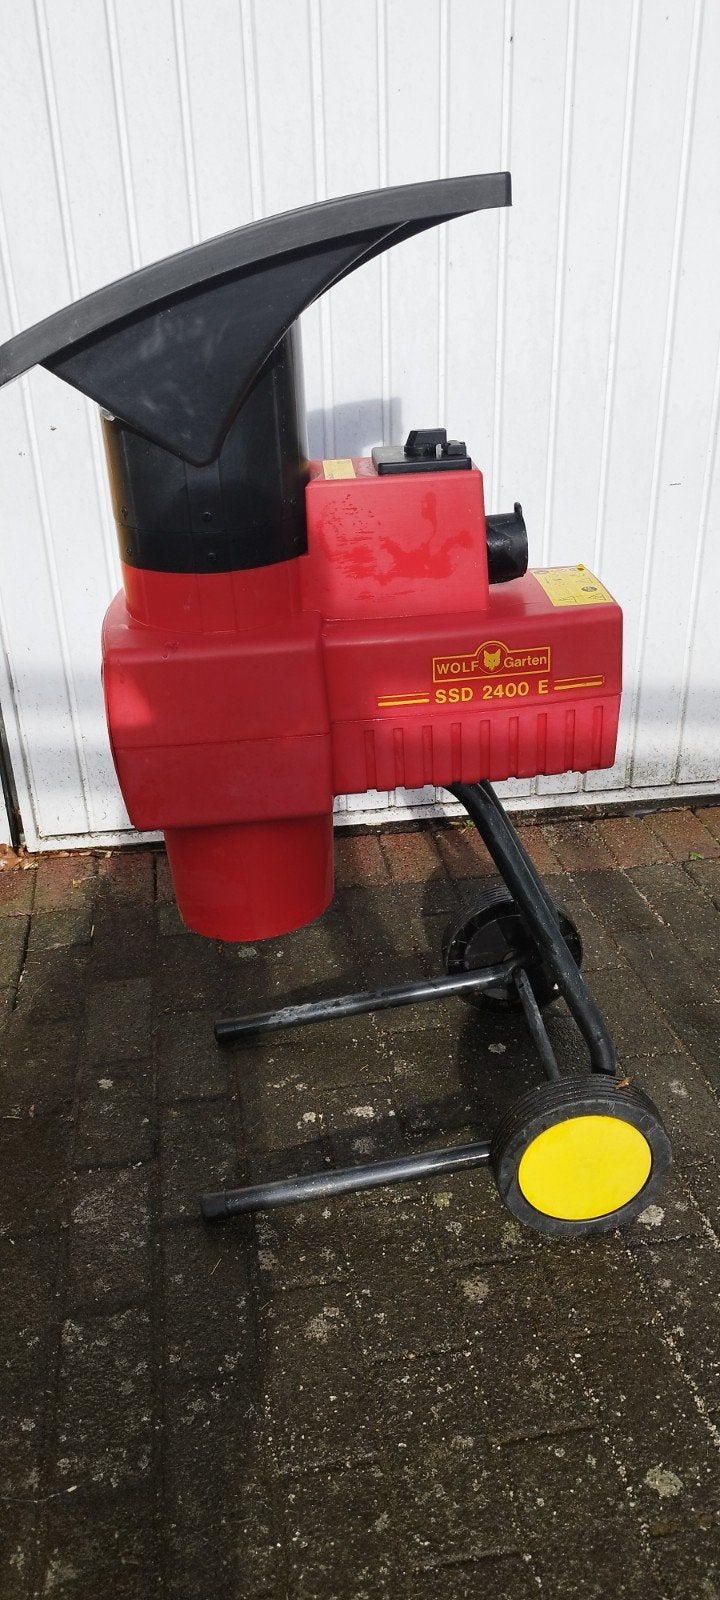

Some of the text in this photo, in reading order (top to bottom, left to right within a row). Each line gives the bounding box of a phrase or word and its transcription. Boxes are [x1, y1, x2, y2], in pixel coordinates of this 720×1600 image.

[436, 655, 547, 675] WOLF Garten
[435, 679, 549, 704] SSD 2400 E
